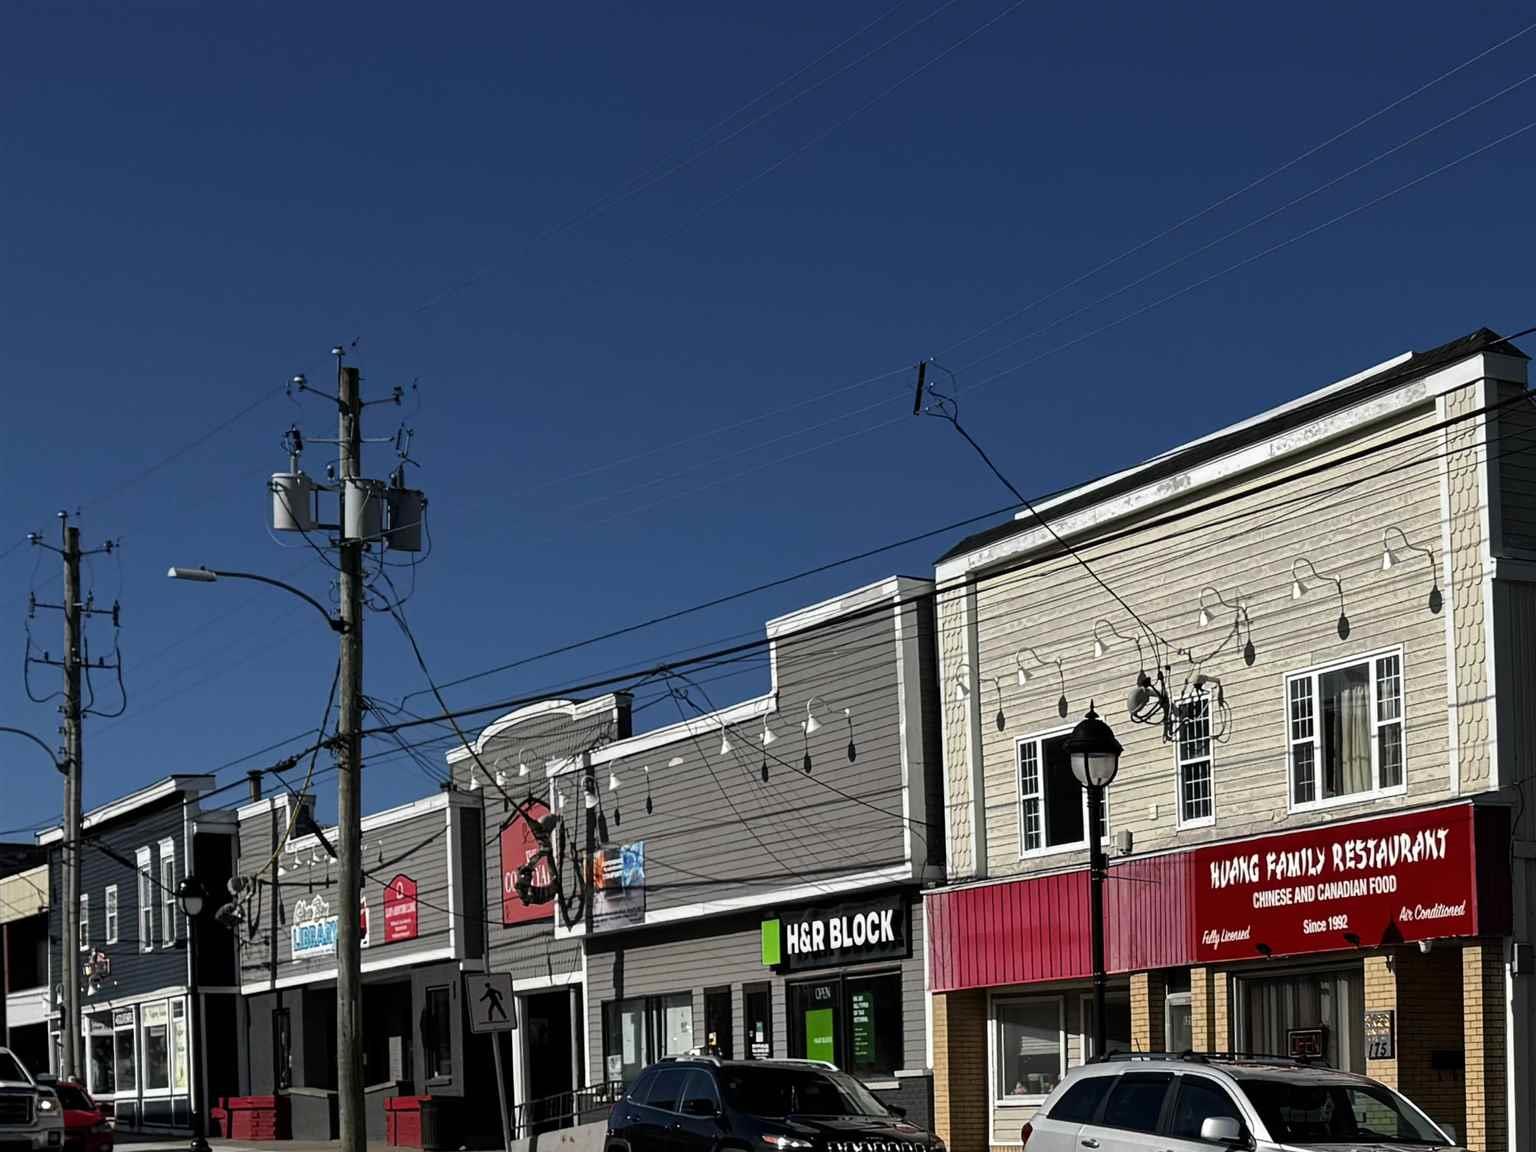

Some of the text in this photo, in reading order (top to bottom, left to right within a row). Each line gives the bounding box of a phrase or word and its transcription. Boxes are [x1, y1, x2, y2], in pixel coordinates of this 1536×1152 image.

[1210, 828, 1450, 889] HUANG FAMILY RESTAURANT
[1252, 875, 1397, 909] CHINESE AND CANADIAN FOOD
[1399, 899, 1466, 921] Air Conditioned
[786, 909, 895, 955] H&R BLOCK
[1303, 914, 1349, 934] Since 1992
[1201, 925, 1251, 950] Fully Licensed
[815, 986, 832, 1000] OPEN
[1368, 1042, 1388, 1058] 175
